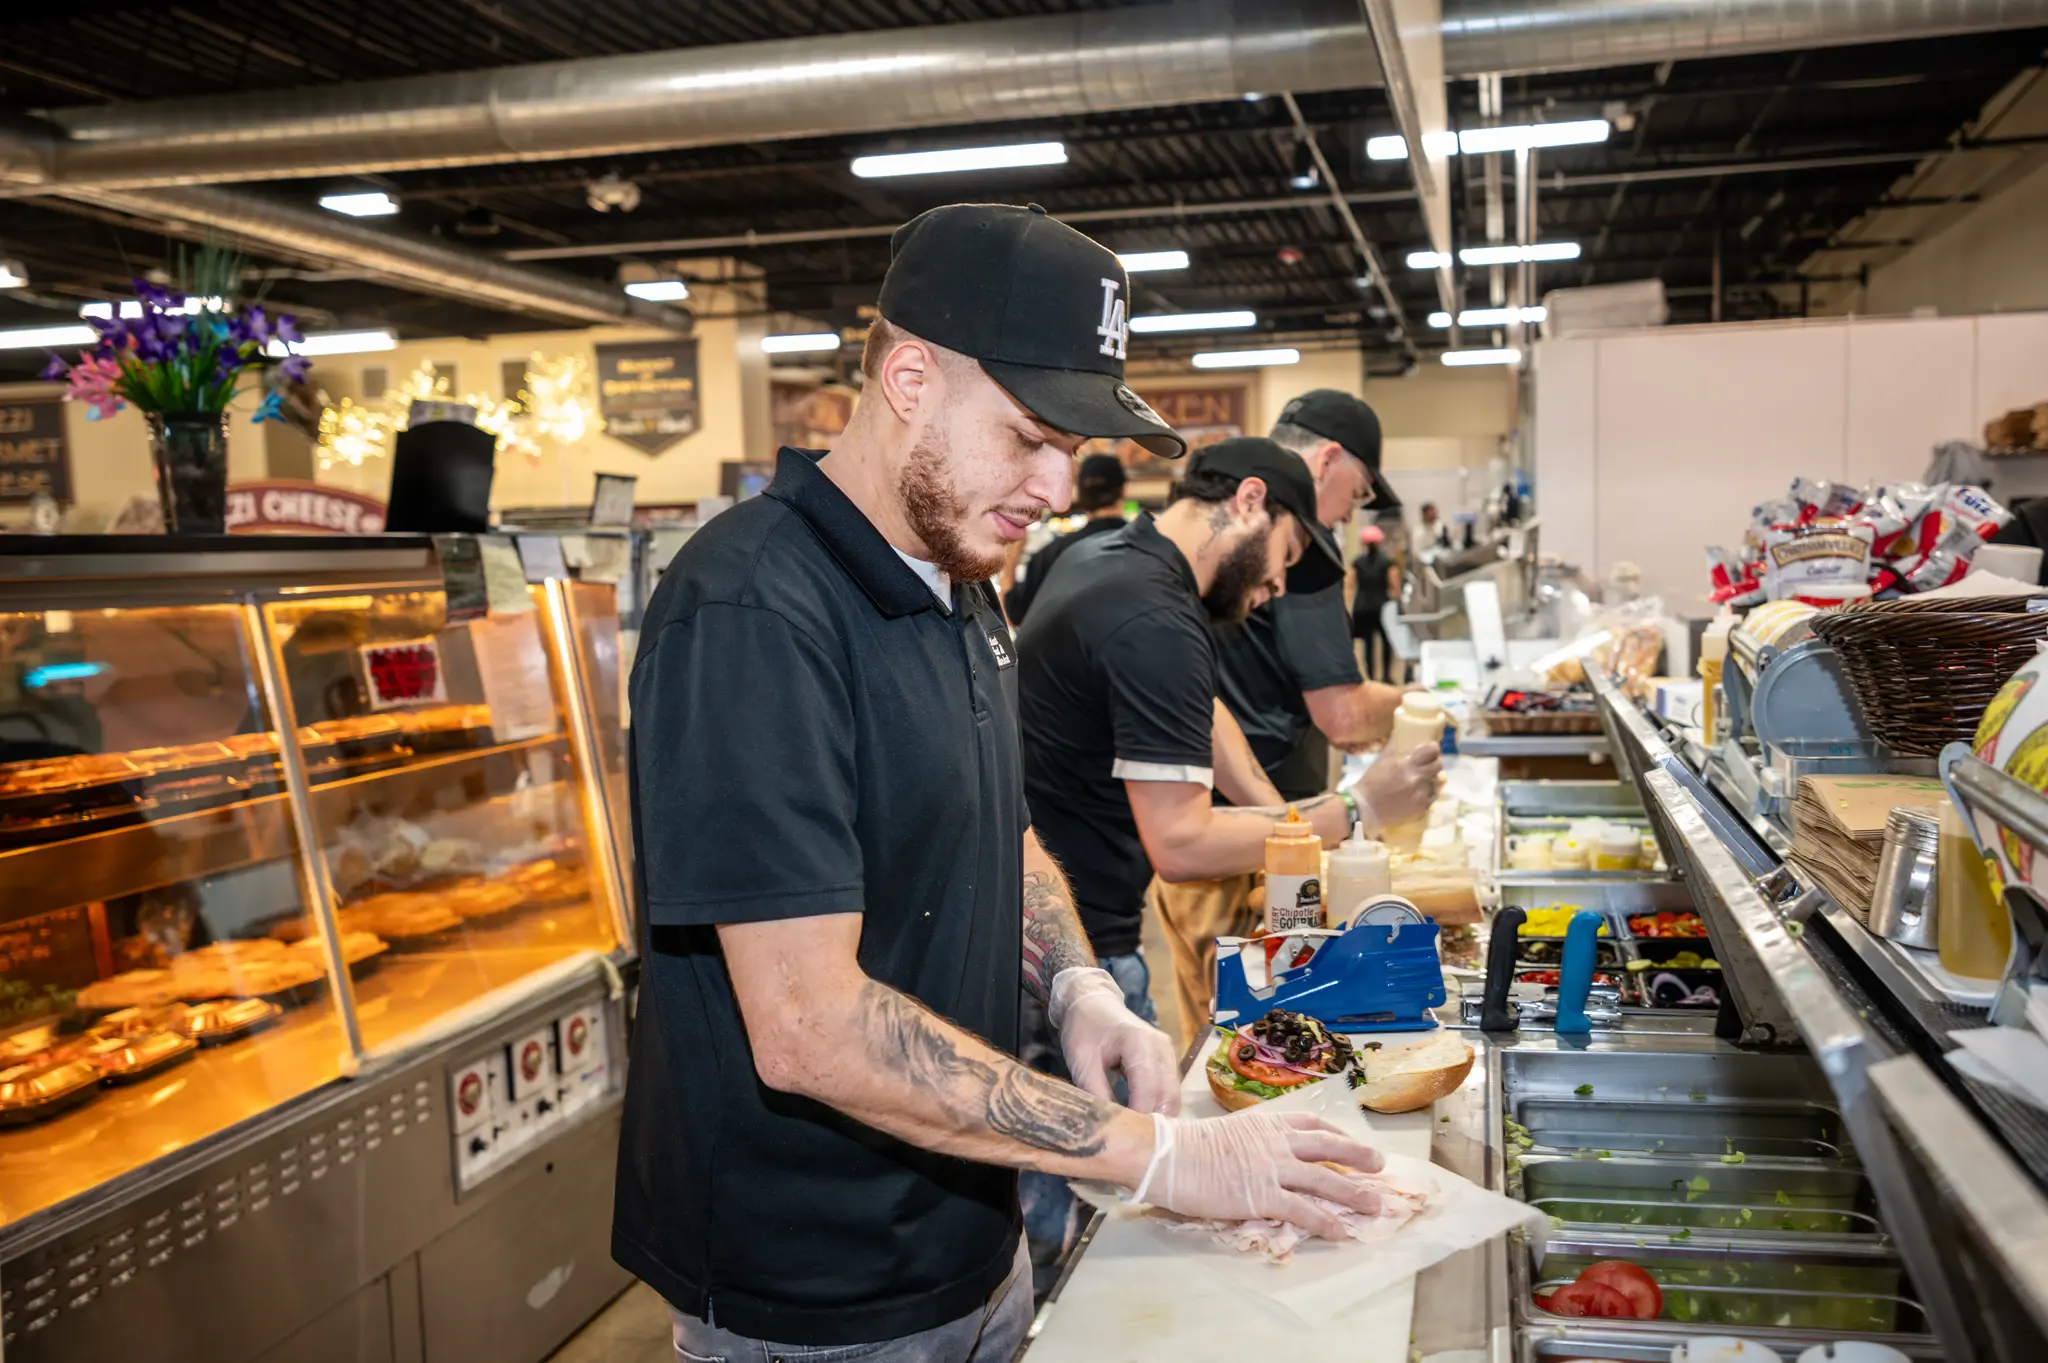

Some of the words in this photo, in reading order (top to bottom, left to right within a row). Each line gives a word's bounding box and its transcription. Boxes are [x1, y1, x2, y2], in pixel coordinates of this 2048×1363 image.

[1097, 278, 1129, 360] LA
[262, 489, 364, 534] CHEESE
[1280, 908, 1313, 917] Chipotle
